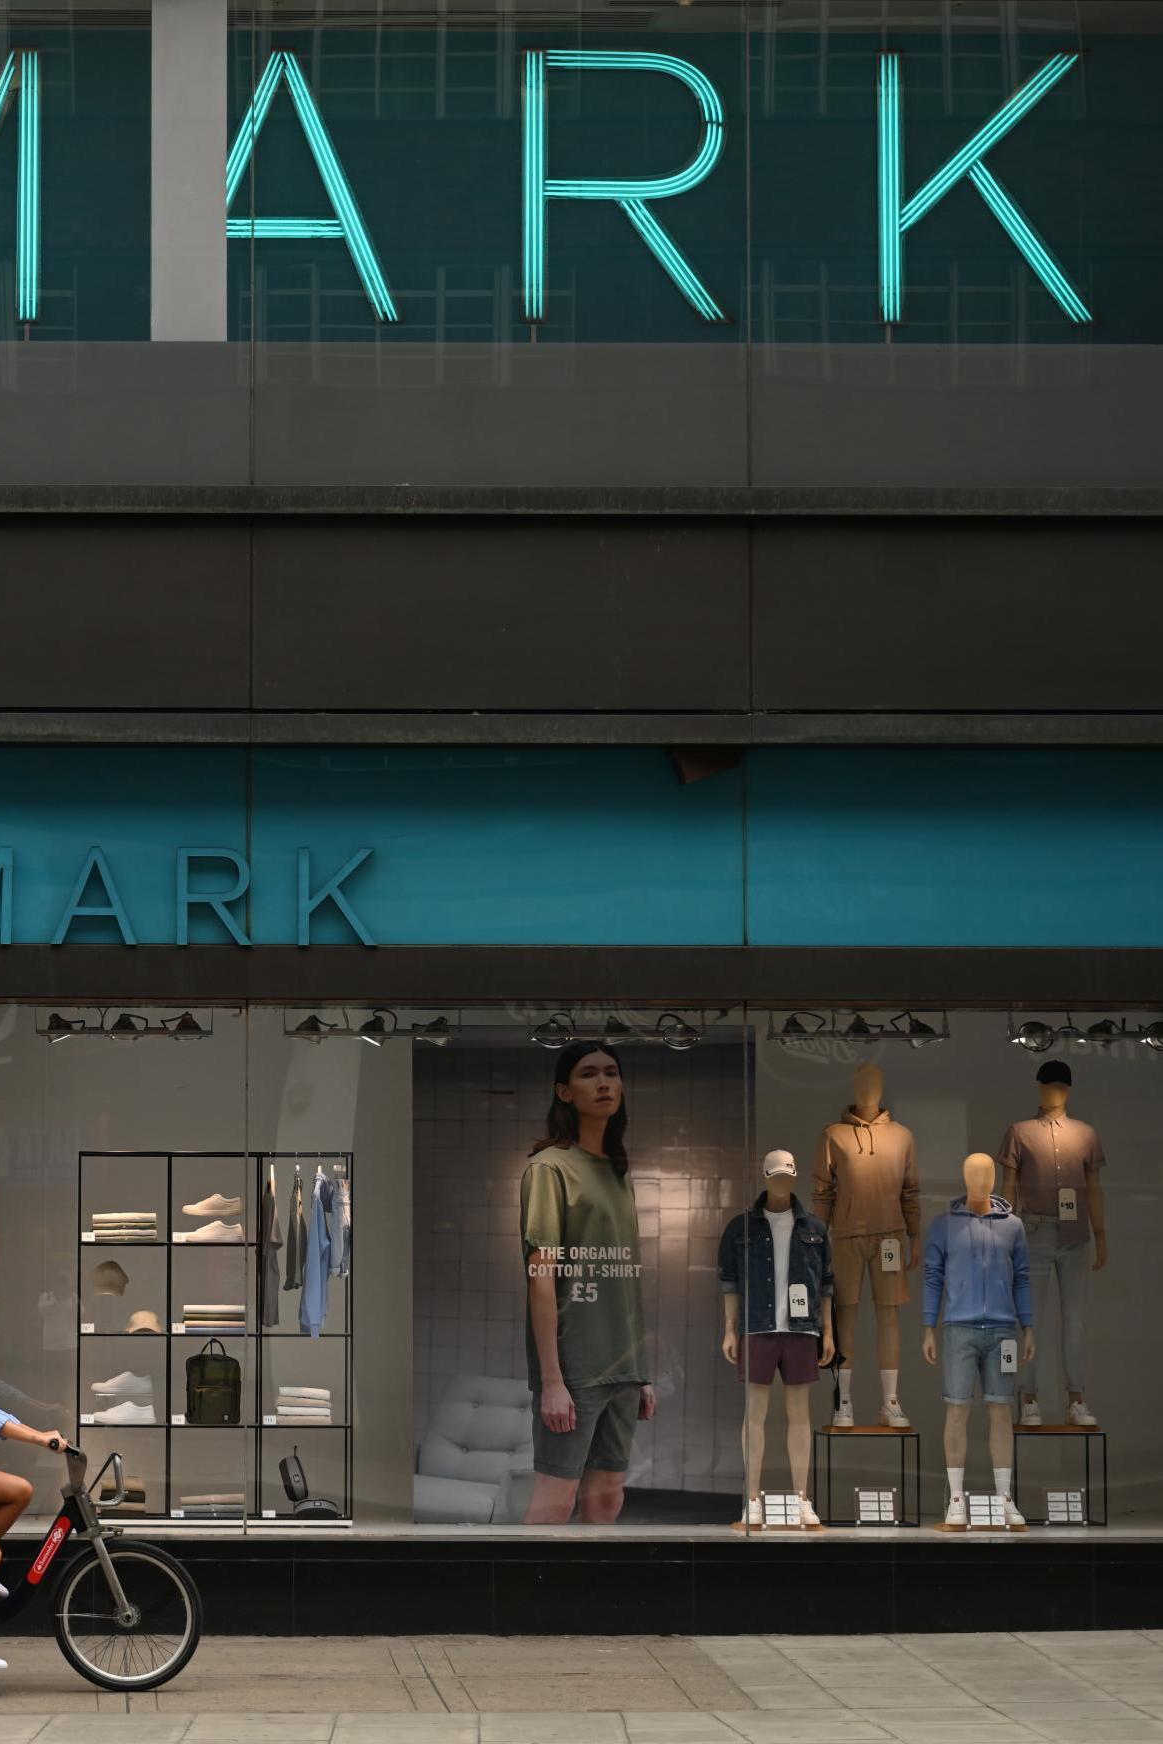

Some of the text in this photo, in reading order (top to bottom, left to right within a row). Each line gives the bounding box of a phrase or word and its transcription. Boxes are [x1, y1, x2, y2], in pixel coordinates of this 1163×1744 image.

[538, 1246, 631, 1260] THE ORGANIC
[884, 1252, 894, 1262] £9
[528, 1263, 642, 1278] COTTON T-SHIRT
[571, 1282, 599, 1303] £5
[791, 1298, 806, 1306] £15
[1002, 1354, 1012, 1363] £8
